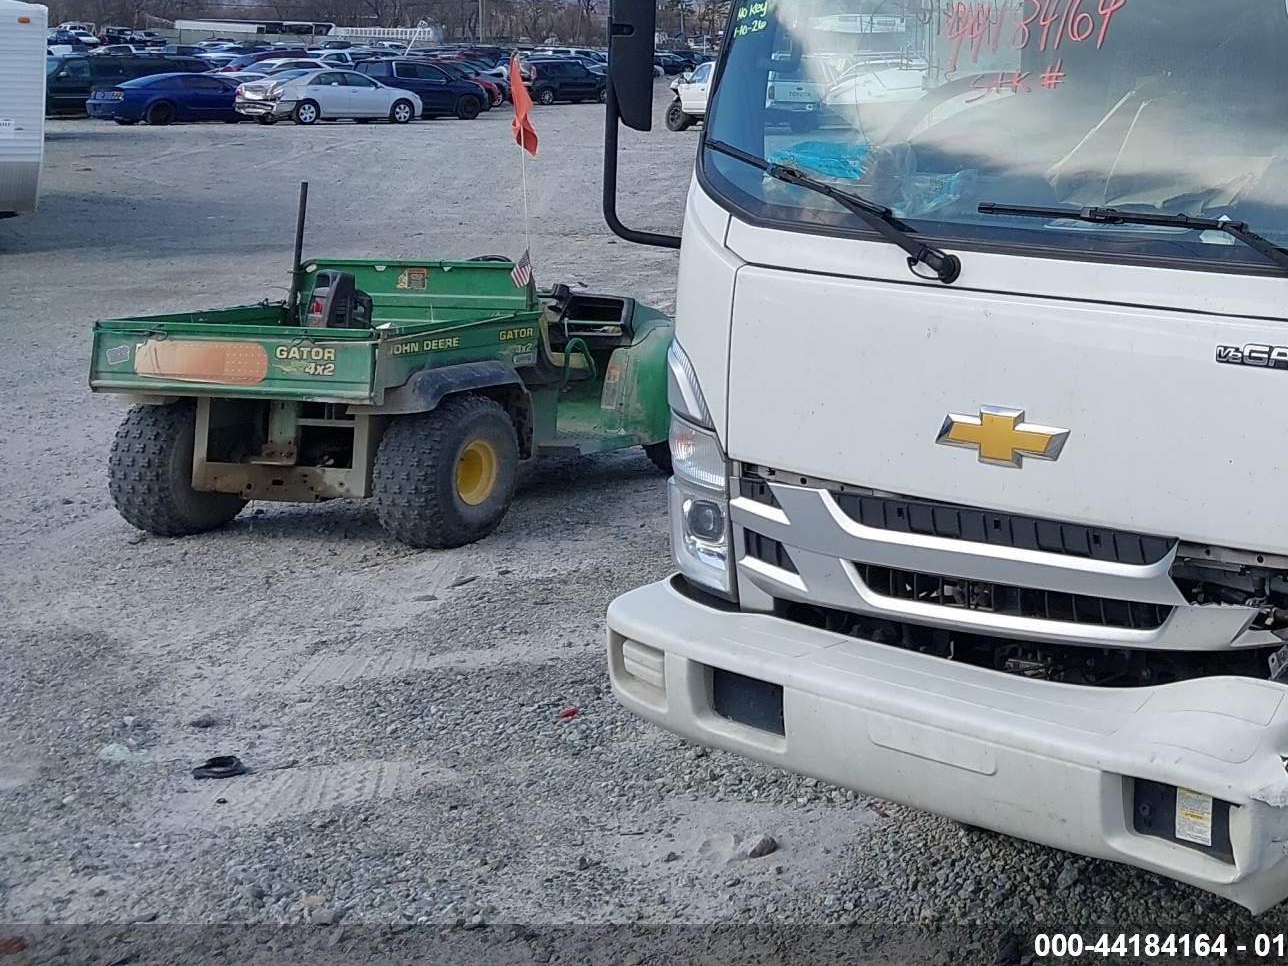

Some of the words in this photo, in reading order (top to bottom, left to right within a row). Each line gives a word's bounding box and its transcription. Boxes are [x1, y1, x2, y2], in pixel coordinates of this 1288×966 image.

[499, 328, 533, 340] GATOR
[423, 337, 460, 351] DEERE
[276, 346, 336, 361] GATOR
[304, 362, 335, 376] 4x2
